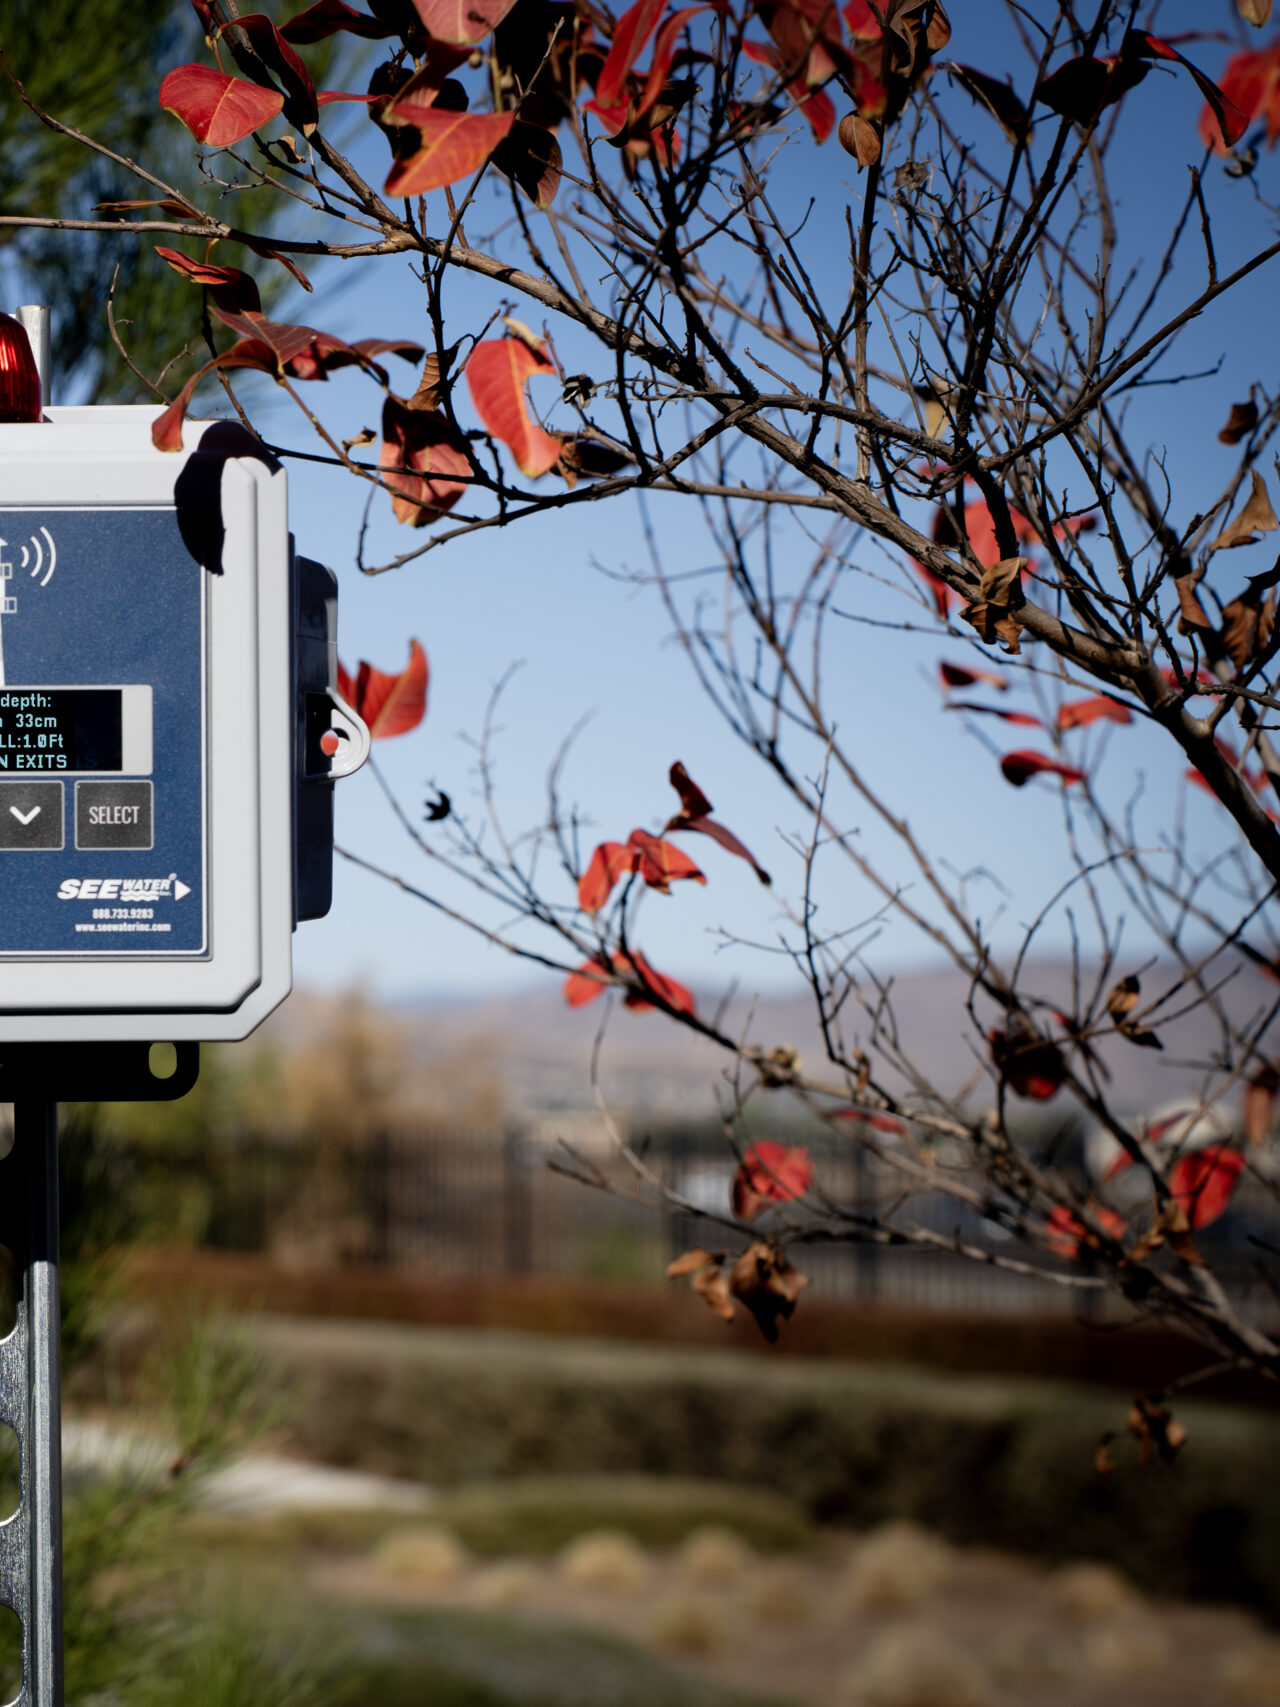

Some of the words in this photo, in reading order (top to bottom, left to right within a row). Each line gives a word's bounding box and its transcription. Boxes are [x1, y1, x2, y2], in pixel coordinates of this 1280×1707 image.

[0, 693, 52, 711] depth:
[15, 713, 57, 728] 33cm
[16, 754, 67, 769] EXITS
[89, 806, 139, 824] SELECT
[57, 879, 122, 900] SEE
[122, 879, 171, 891] WATER
[92, 908, 154, 919] 888.733.9283
[75, 923, 171, 932] www.seewaterinc.com
